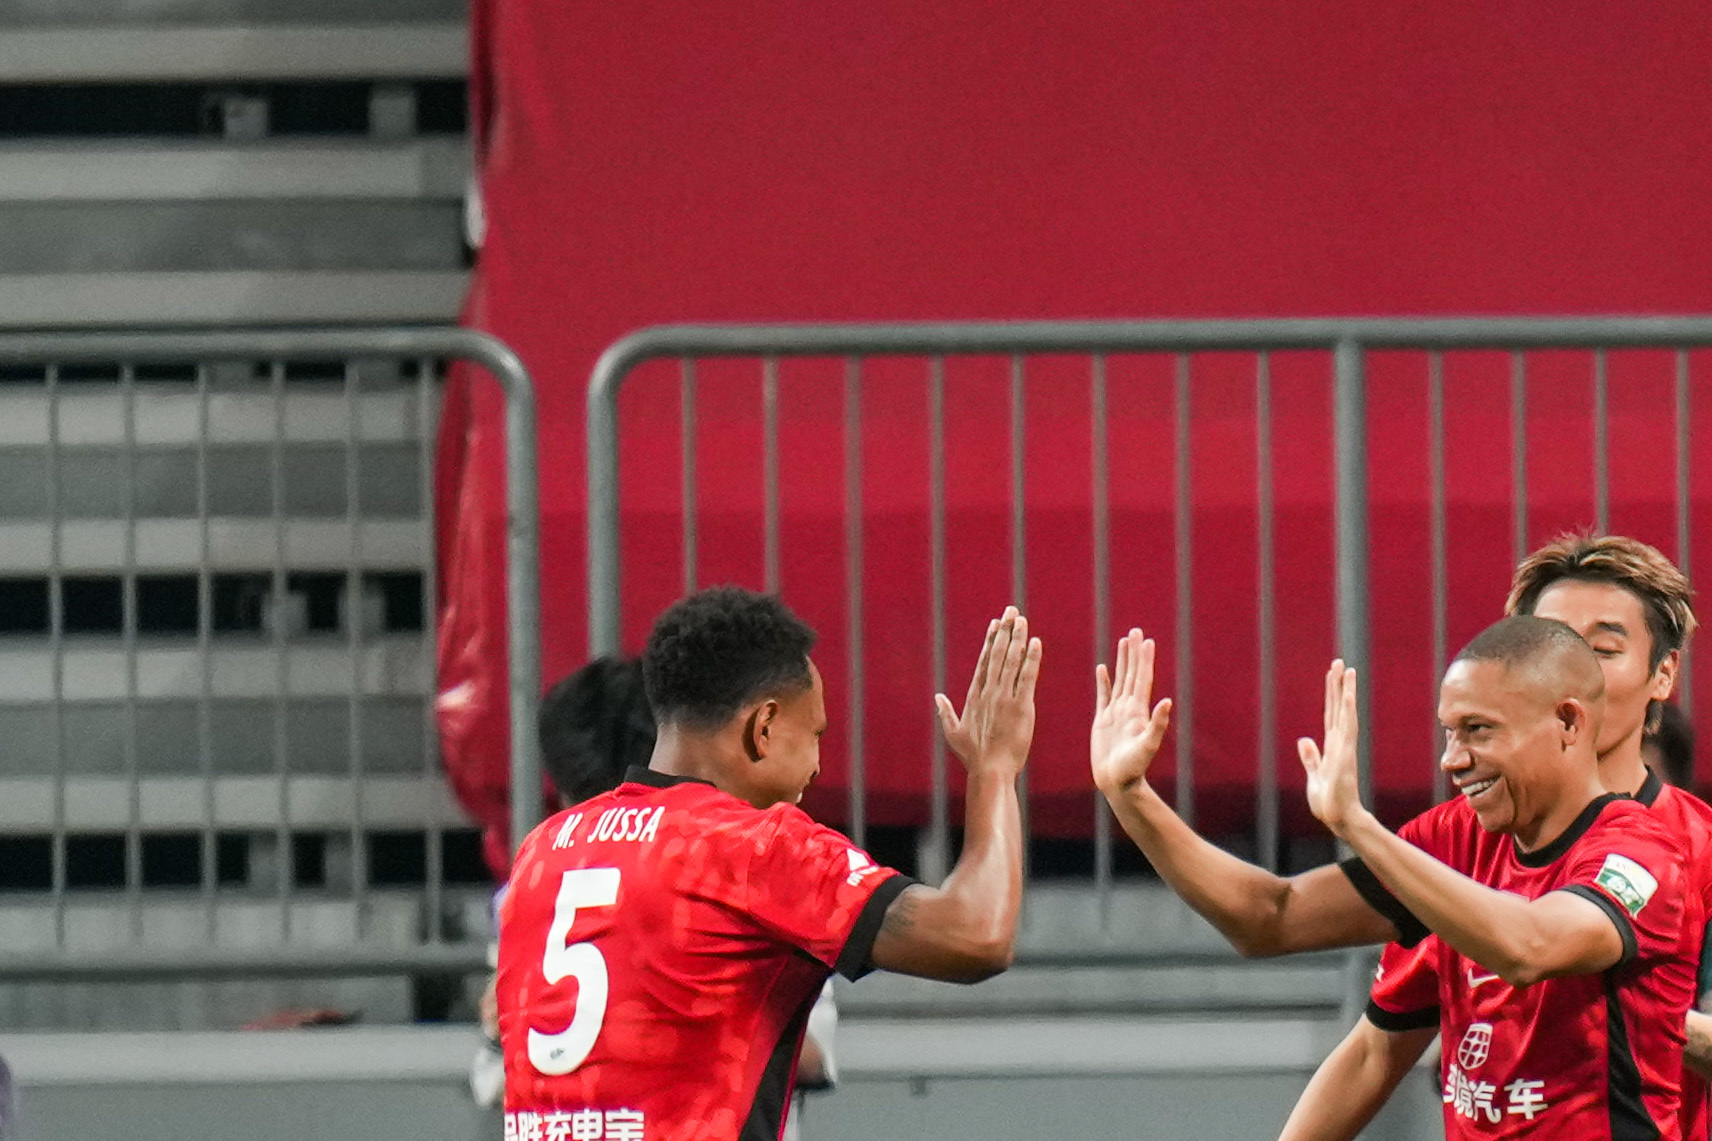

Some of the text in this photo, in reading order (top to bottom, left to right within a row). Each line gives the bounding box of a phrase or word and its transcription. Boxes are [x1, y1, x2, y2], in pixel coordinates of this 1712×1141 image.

[552, 805, 666, 851] M. JUSSA
[526, 866, 622, 1077] 5
